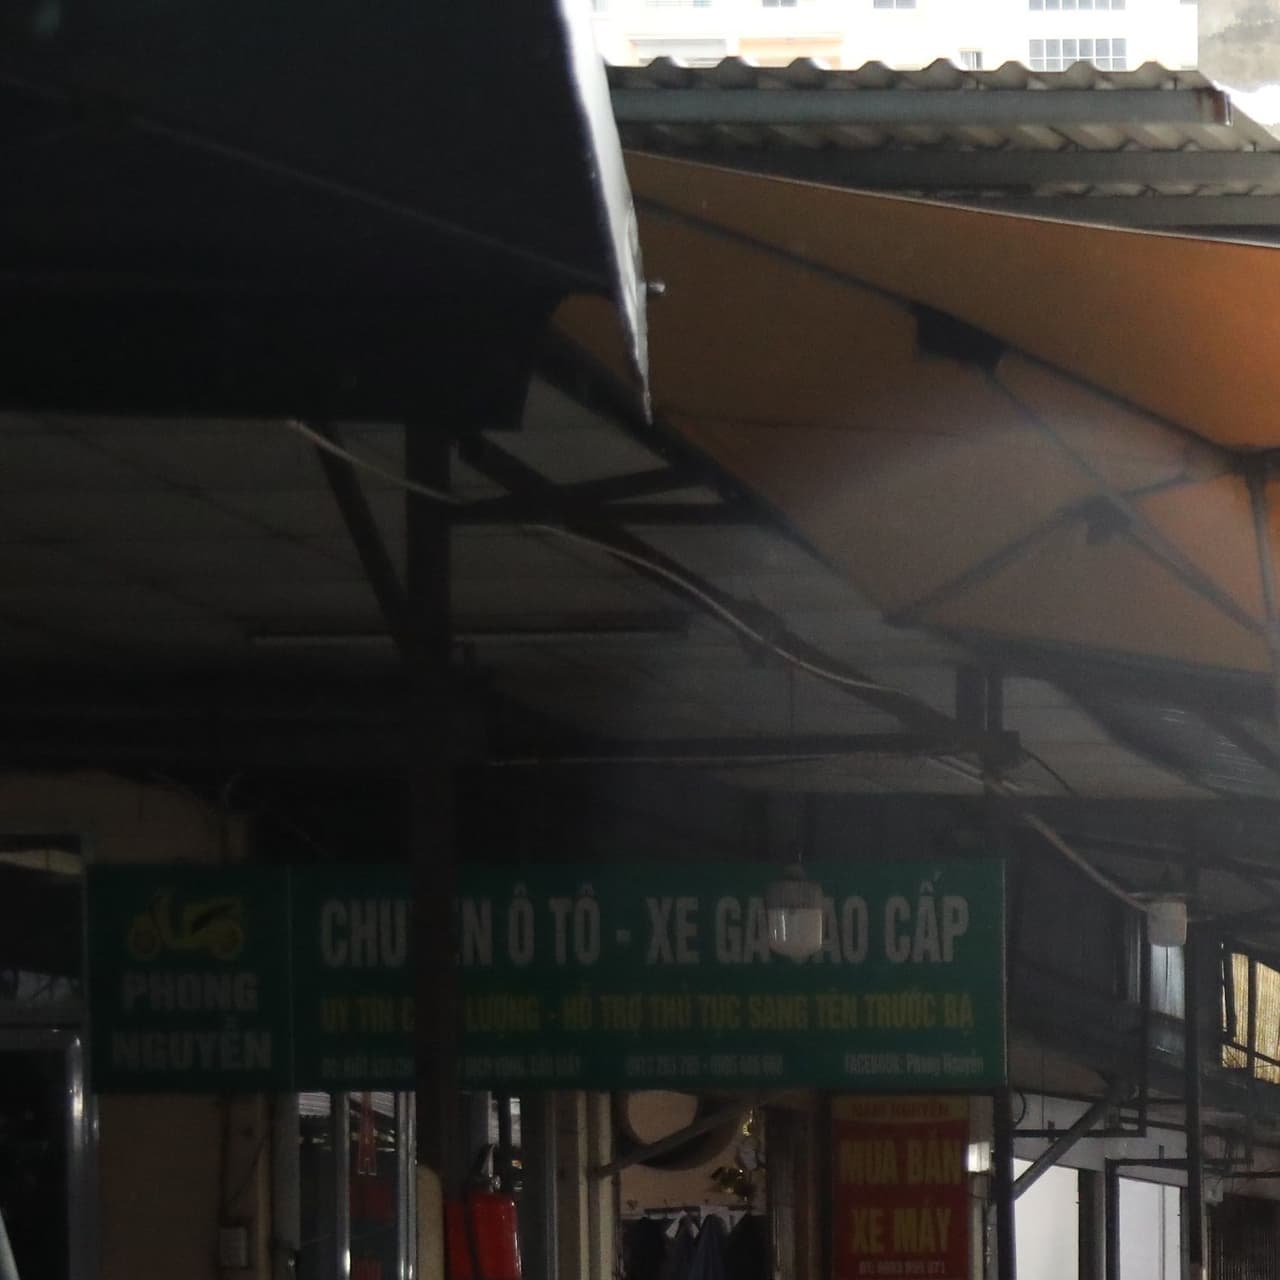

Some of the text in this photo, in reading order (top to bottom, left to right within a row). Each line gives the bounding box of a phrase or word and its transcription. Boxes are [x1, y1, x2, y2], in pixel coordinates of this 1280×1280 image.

[320, 896, 493, 967] CHUN
[507, 881, 536, 967] Ô
[548, 881, 602, 967] TÔ
[646, 896, 700, 965] XE
[816, 896, 869, 964] AO
[885, 871, 970, 964] CẤP
[121, 970, 259, 1014] PHONG
[840, 1128, 963, 1185] MUA BÁN
[849, 1196, 951, 1255] XE MÁY
